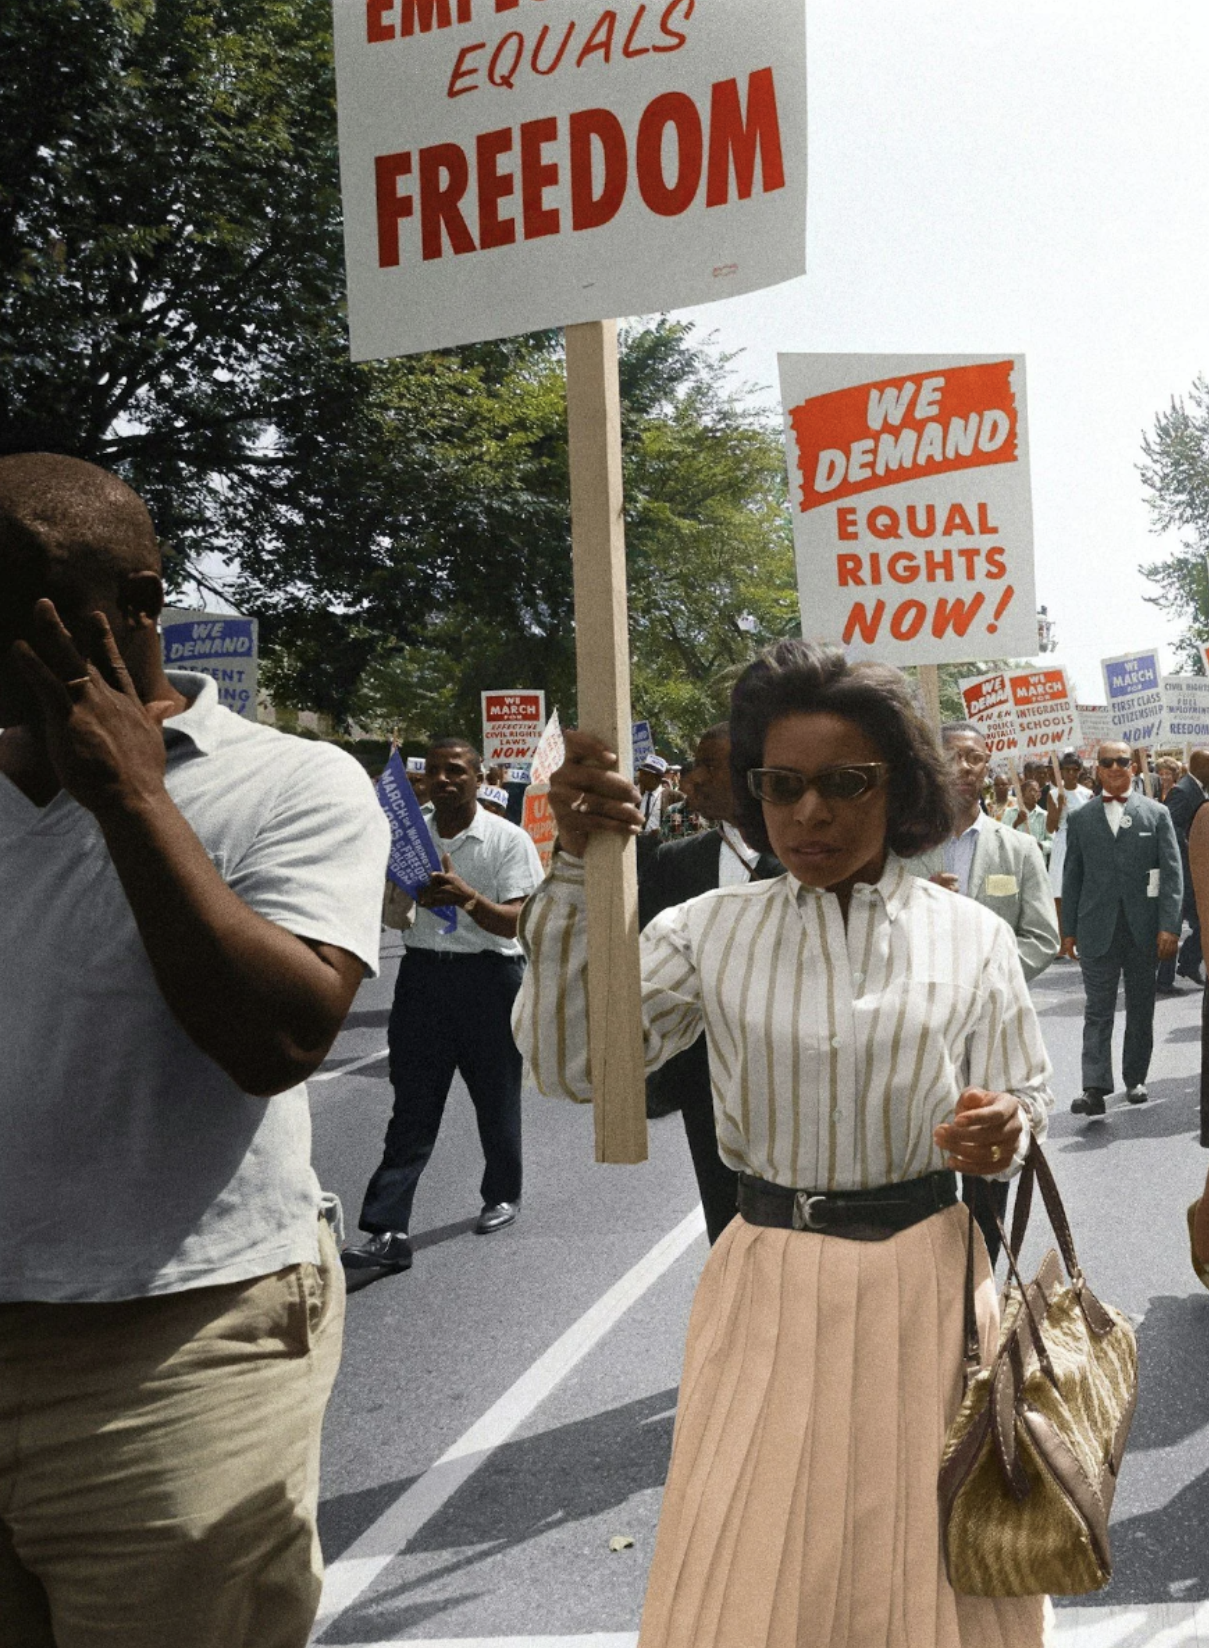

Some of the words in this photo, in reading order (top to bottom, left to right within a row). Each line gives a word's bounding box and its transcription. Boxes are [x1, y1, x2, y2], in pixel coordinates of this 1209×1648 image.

[447, 0, 694, 99] EQUALS
[375, 66, 785, 268] FREEDOM
[867, 376, 945, 431] WE
[814, 409, 1010, 493] DEMAND
[836, 503, 999, 541] EQUAL
[836, 547, 1007, 587] RIGHTS
[842, 585, 1014, 646] NOW!
[192, 622, 224, 639] WE
[170, 637, 250, 659] DEMAND
[1124, 661, 1138, 672] WE
[982, 678, 1003, 695] WE
[1029, 674, 1045, 683] WE
[1113, 668, 1153, 688] MARCH
[1017, 681, 1062, 697] MARCH
[490, 705, 536, 715] MARCH
[970, 690, 1007, 713] DEMA
[1016, 702, 1070, 719] INTEGRATED
[1112, 699, 1135, 712] FIRST
[1137, 692, 1161, 707] CLASS
[977, 712, 993, 723] AN
[997, 709, 1011, 719] EN
[1019, 714, 1073, 732] SCHOOLS
[1112, 704, 1163, 725] CITIZENSHIP
[986, 728, 1016, 740] RUTALIT
[987, 721, 1014, 732] POLICE
[1122, 720, 1162, 742] NOW!
[1170, 723, 1209, 735] REEDOM
[1027, 726, 1072, 748] NOW!
[491, 747, 537, 759] NOW!
[512, 771, 530, 780] UA
[382, 769, 408, 820] MARCH
[406, 827, 431, 869] WASHINGT
